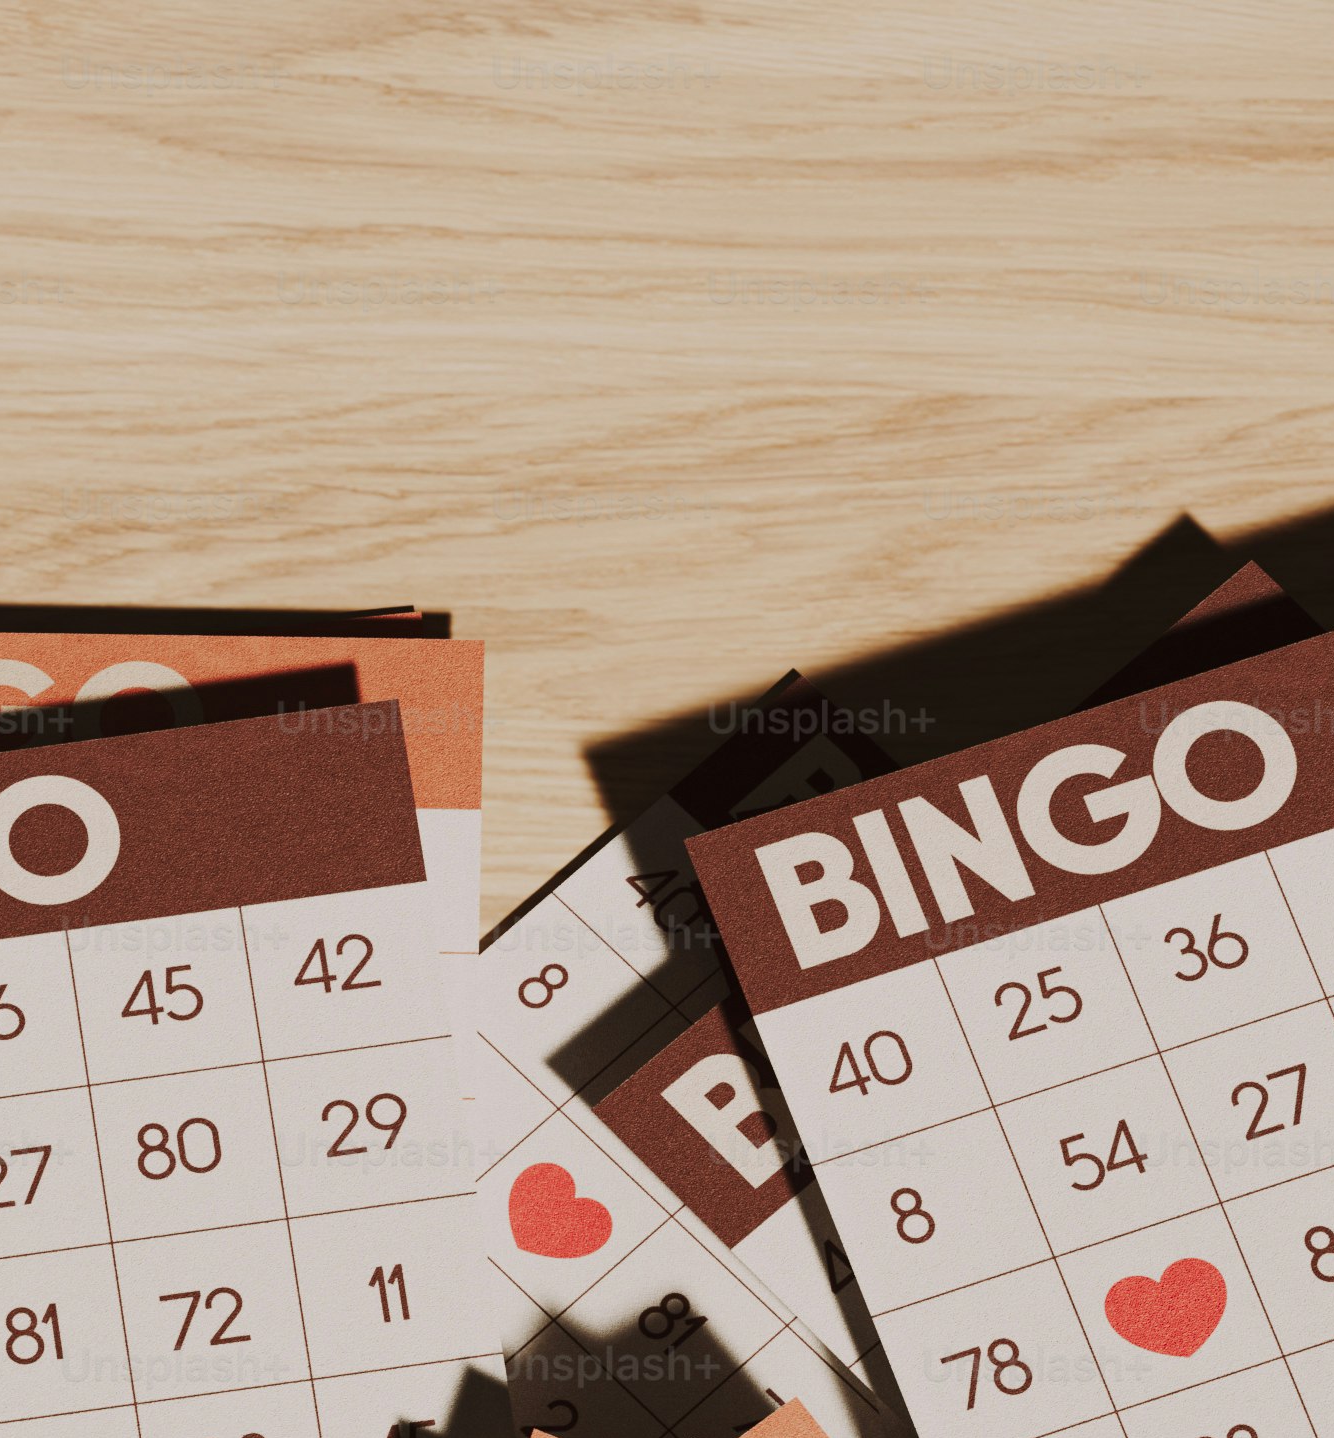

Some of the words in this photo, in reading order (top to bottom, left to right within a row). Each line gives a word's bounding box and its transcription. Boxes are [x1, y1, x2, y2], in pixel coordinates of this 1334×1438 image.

[754, 700, 1298, 970] BINGO
[121, 964, 204, 1025] 45
[294, 934, 381, 993] 42
[518, 964, 569, 1009] 8
[829, 1030, 913, 1095] 40
[994, 966, 1083, 1041] 25
[1164, 914, 1249, 982] 36
[137, 1117, 222, 1180] 80
[321, 1093, 407, 1157] 29
[890, 1187, 935, 1244] 8
[1060, 1119, 1148, 1191] 54
[1231, 1063, 1307, 1141] 27
[6, 1303, 63, 1365] 81
[159, 1287, 251, 1351] 72
[369, 1264, 410, 1323] 11
[940, 1338, 1033, 1410] 78
